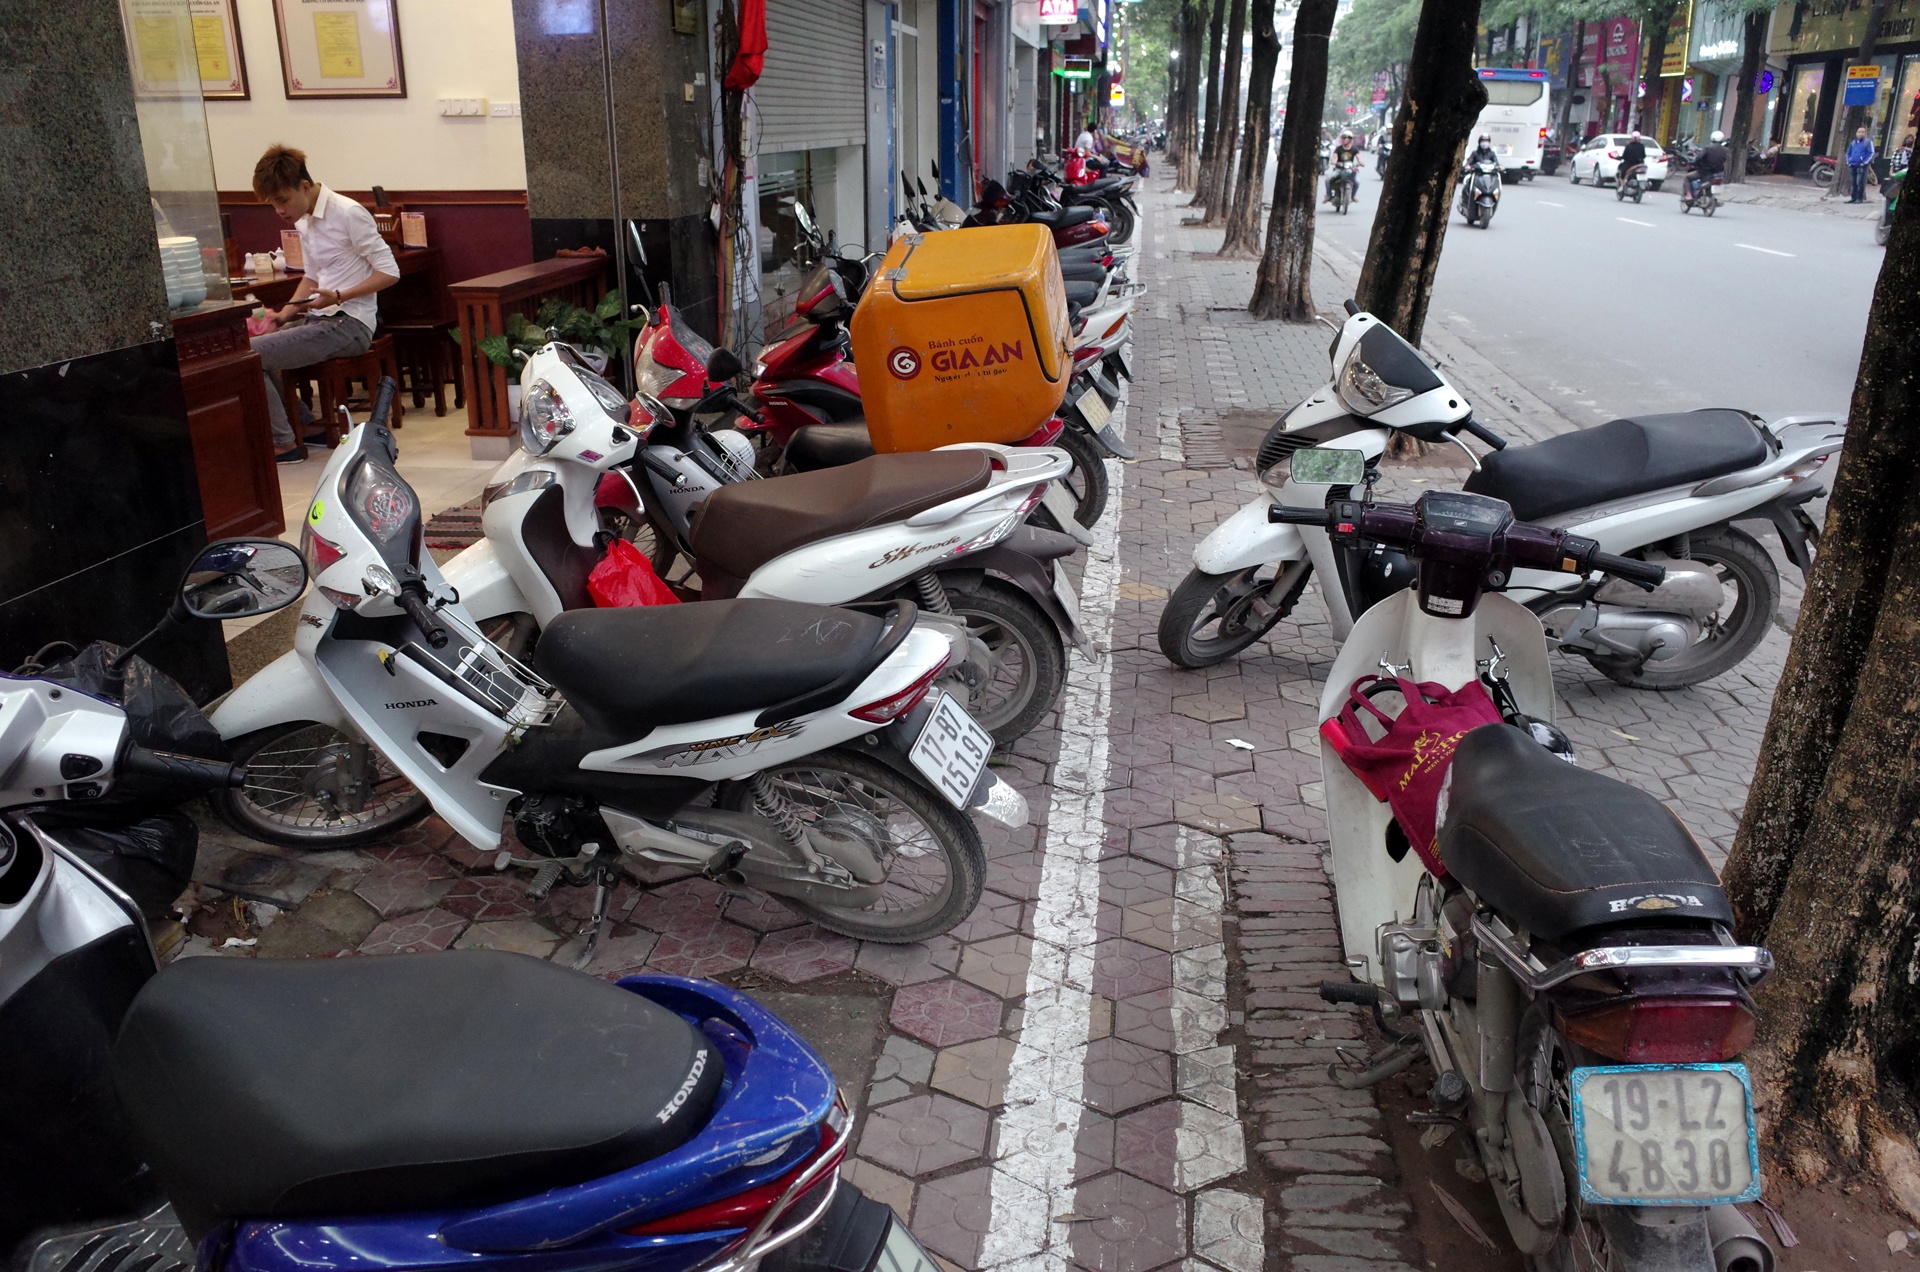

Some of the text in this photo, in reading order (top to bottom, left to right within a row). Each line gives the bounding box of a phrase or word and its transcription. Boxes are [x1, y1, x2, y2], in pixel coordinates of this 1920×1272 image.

[1041, 0, 1075, 14] ATM
[928, 333, 984, 350] Bánh cuốn
[669, 485, 706, 494] HONDA
[384, 698, 438, 710] HONDA
[690, 736, 742, 751] WAVE
[920, 703, 962, 769] 17-B7
[941, 722, 989, 799] 151.91
[656, 1048, 708, 1125] HONDA
[1607, 1137, 1733, 1193] 4830
